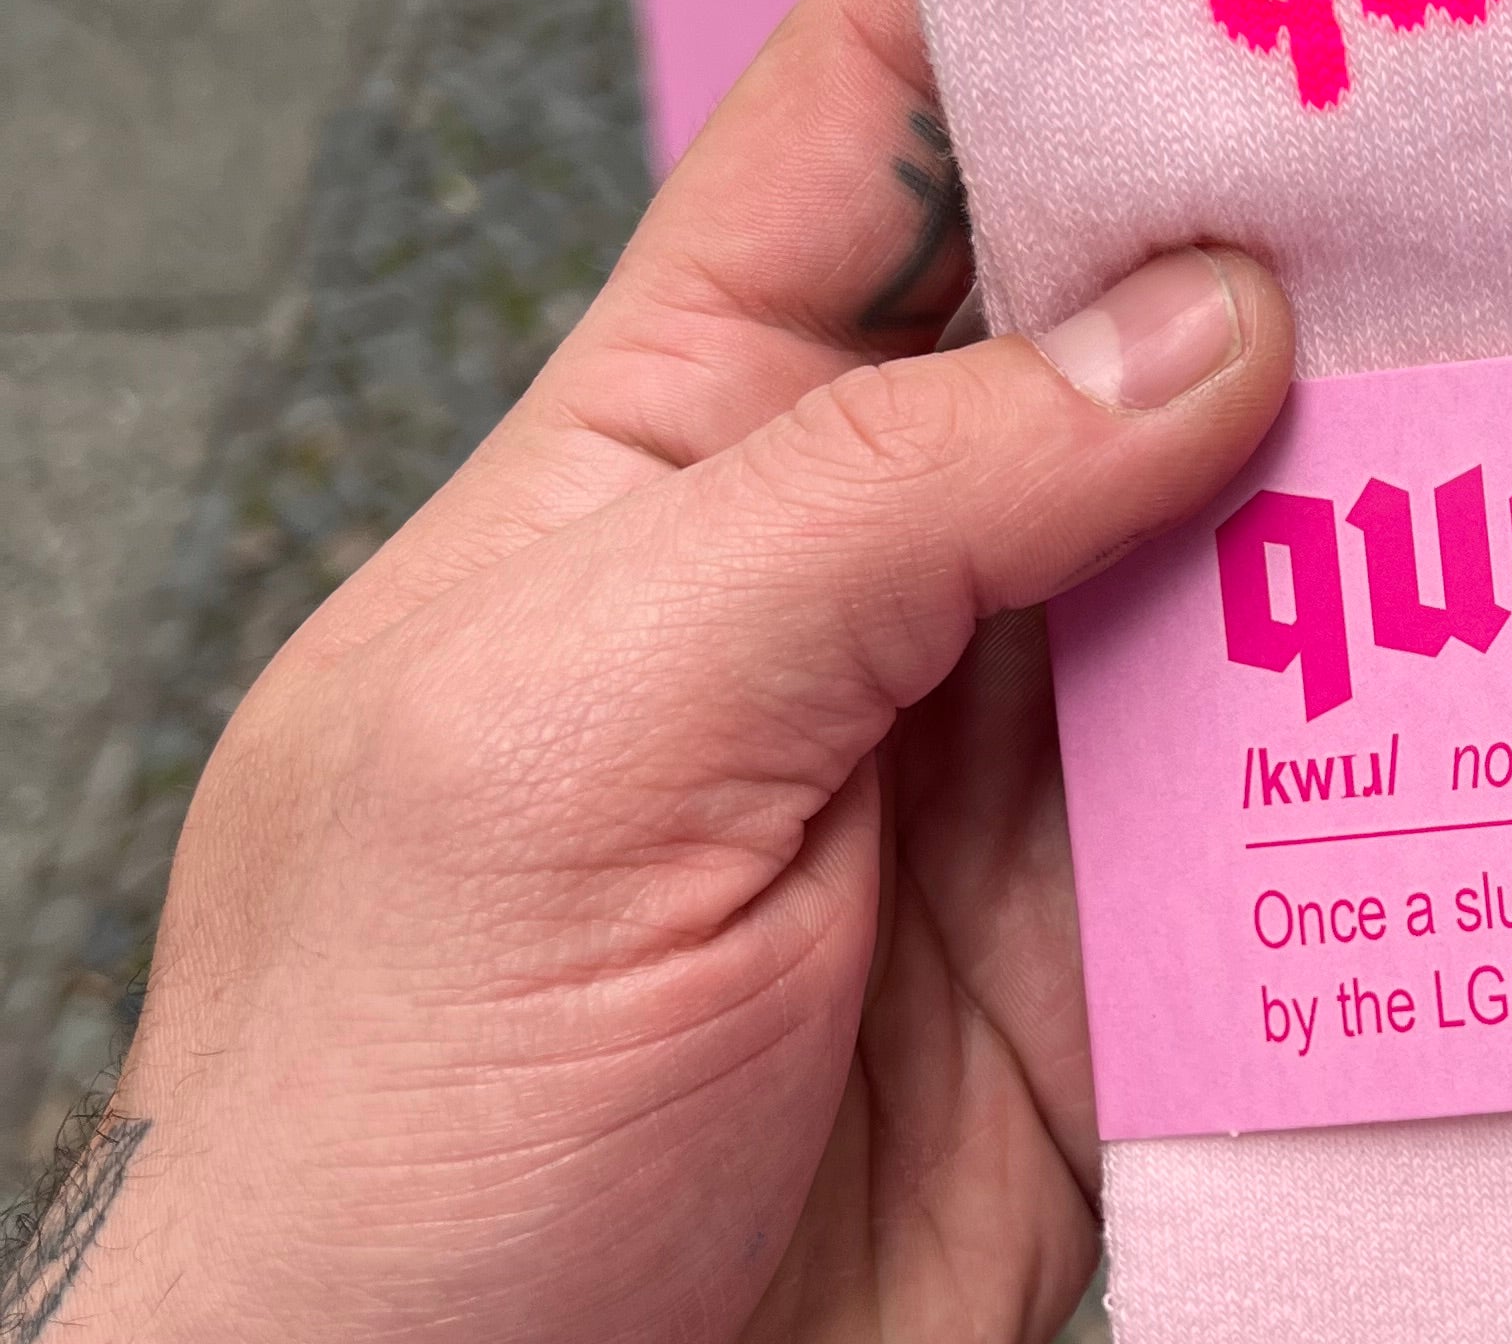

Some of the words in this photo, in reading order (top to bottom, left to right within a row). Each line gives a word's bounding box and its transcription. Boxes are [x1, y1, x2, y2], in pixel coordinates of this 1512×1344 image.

[1253, 888, 1387, 950] Once
[1405, 892, 1436, 937] a
[1261, 985, 1319, 1057] by
[1336, 977, 1416, 1038] the
